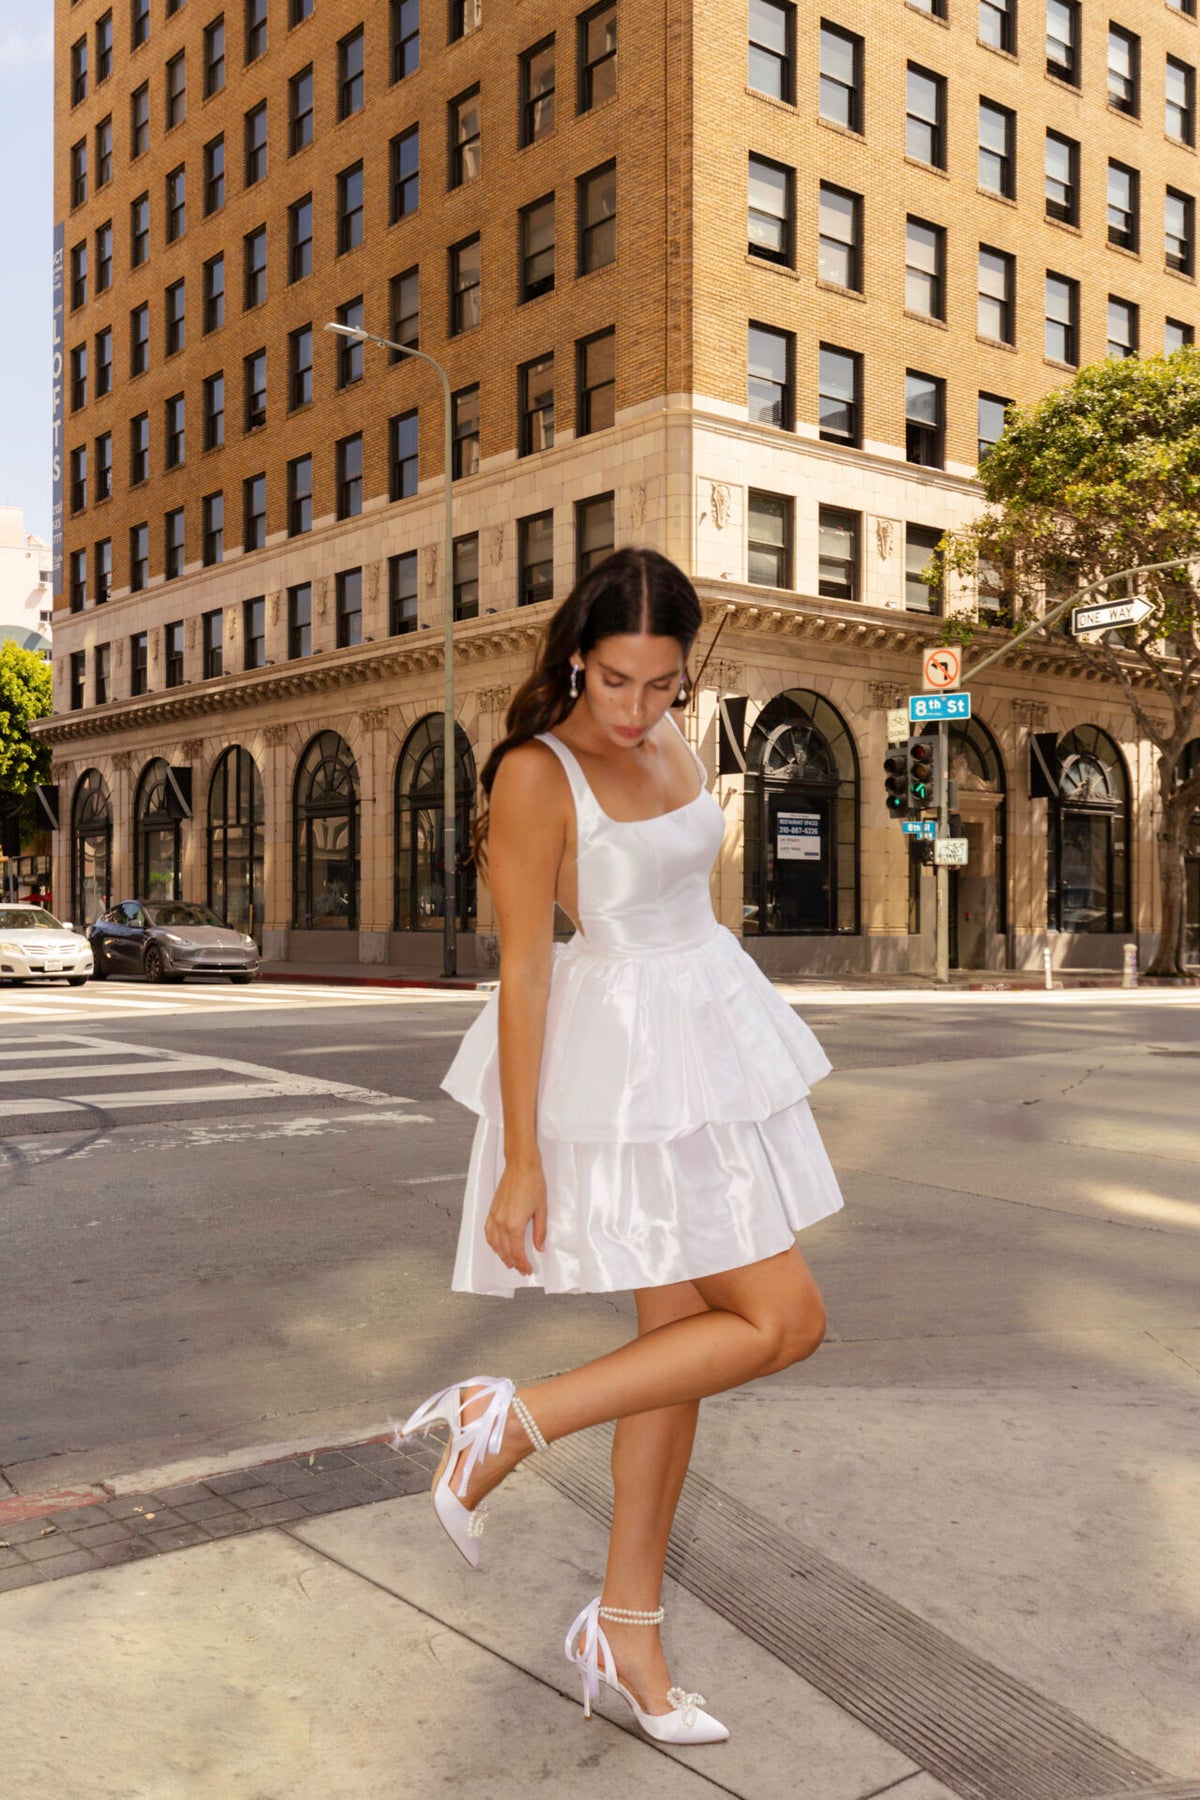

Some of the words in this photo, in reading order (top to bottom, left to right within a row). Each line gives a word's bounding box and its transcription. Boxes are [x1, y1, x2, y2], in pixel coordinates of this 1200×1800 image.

[52, 319, 62, 482] LOFTS
[1080, 612, 1101, 626] ONE
[1109, 606, 1132, 620] WAY
[915, 699, 941, 717] 8th
[947, 699, 965, 713] St
